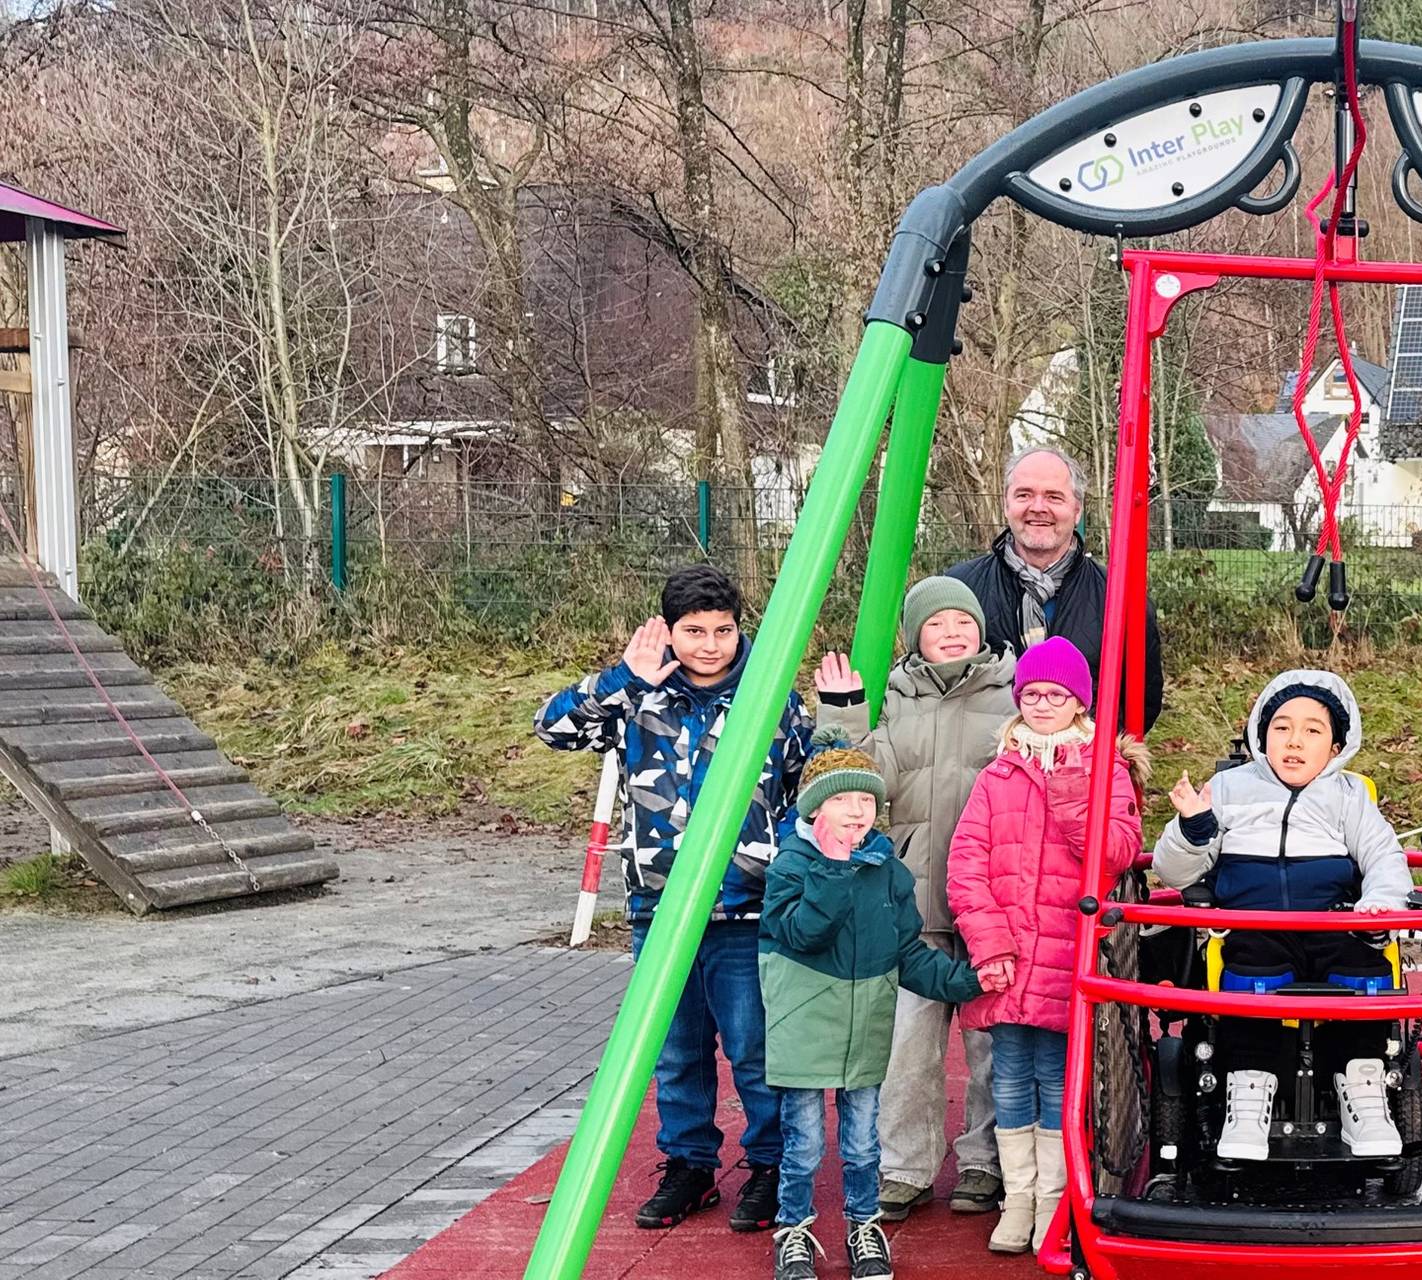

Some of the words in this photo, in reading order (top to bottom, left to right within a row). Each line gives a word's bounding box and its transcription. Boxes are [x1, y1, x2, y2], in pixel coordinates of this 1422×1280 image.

[1128, 135, 1185, 167] Inter
[1191, 115, 1244, 145] Play
[1177, 137, 1236, 161] PLAYGROUNDS
